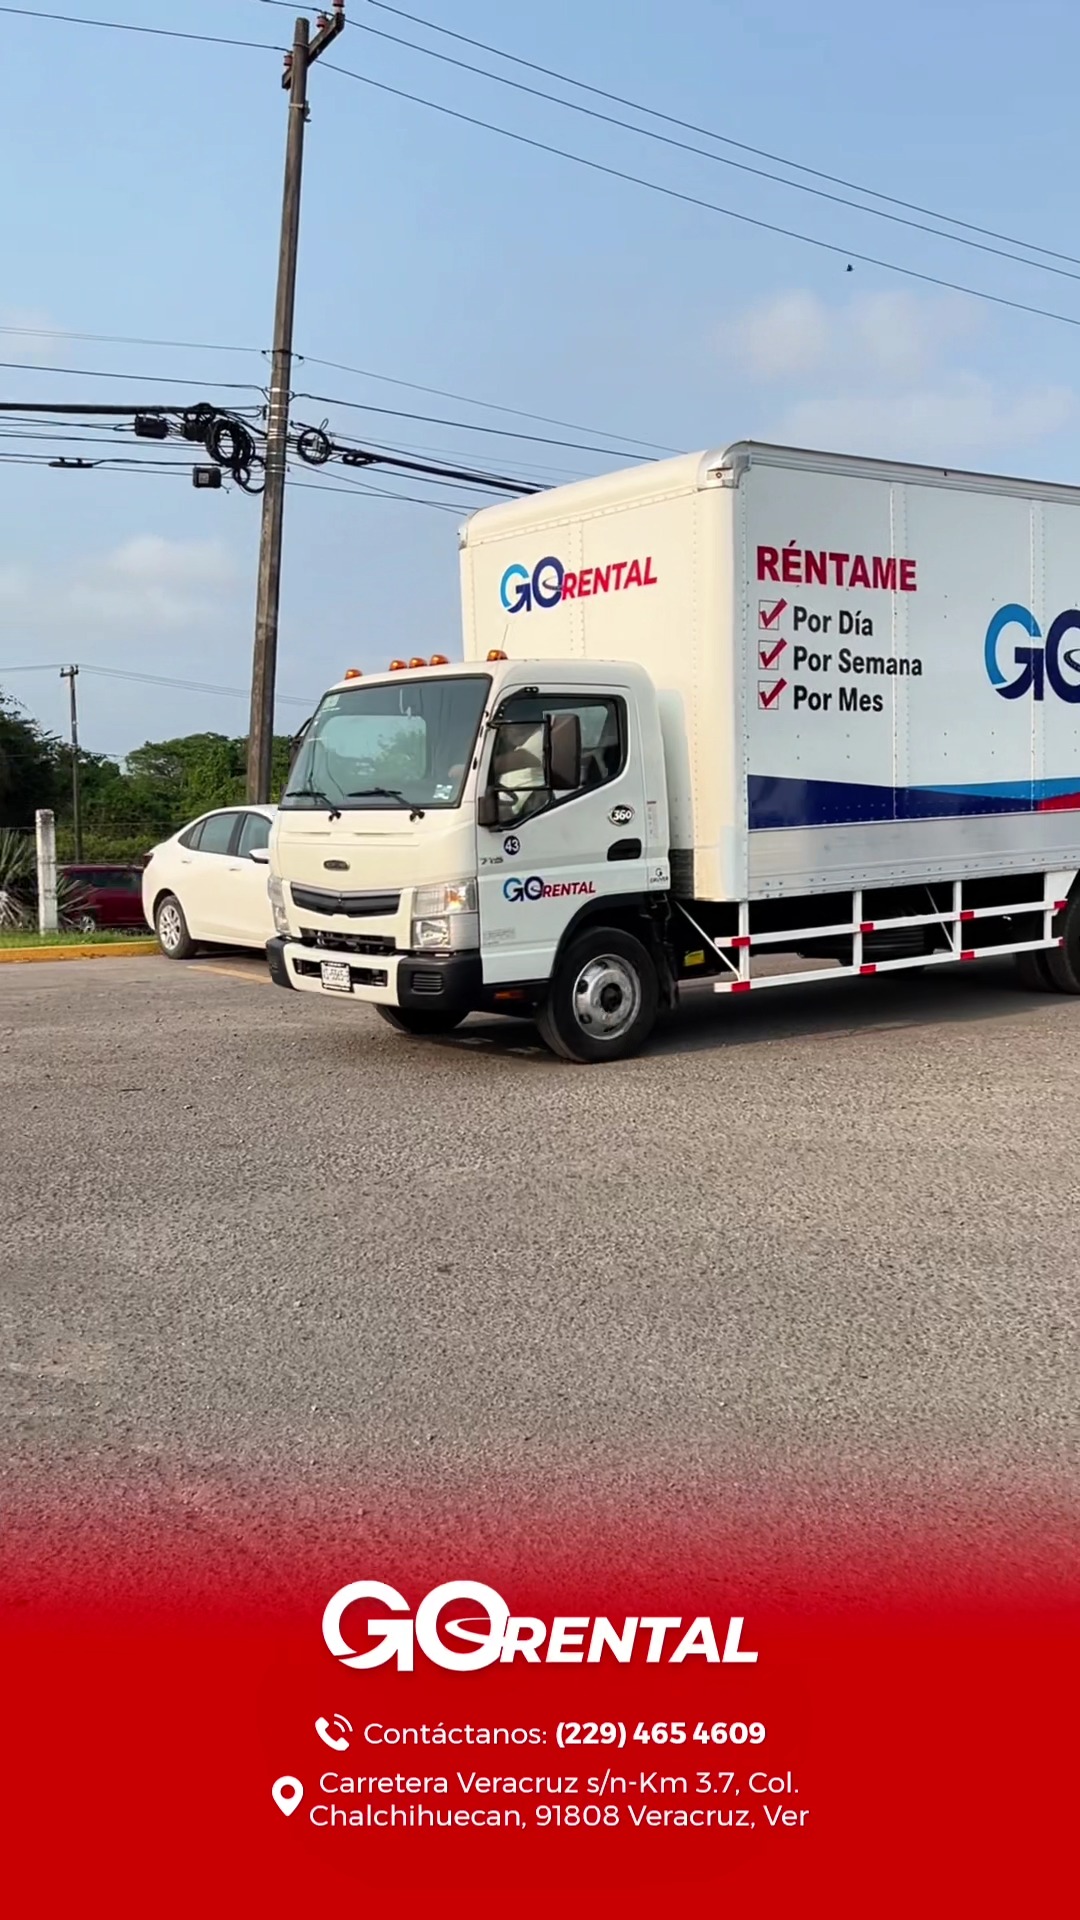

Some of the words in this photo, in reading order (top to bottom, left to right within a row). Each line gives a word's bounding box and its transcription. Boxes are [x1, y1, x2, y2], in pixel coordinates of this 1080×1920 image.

[756, 540, 917, 591] RÉNTAME
[793, 605, 832, 633] Por
[839, 610, 873, 636] Día
[793, 645, 832, 672] Por
[838, 648, 922, 676] Semana
[793, 685, 832, 710] Por
[839, 687, 884, 712] Mes
[613, 809, 632, 820] 360
[505, 839, 518, 852] 43
